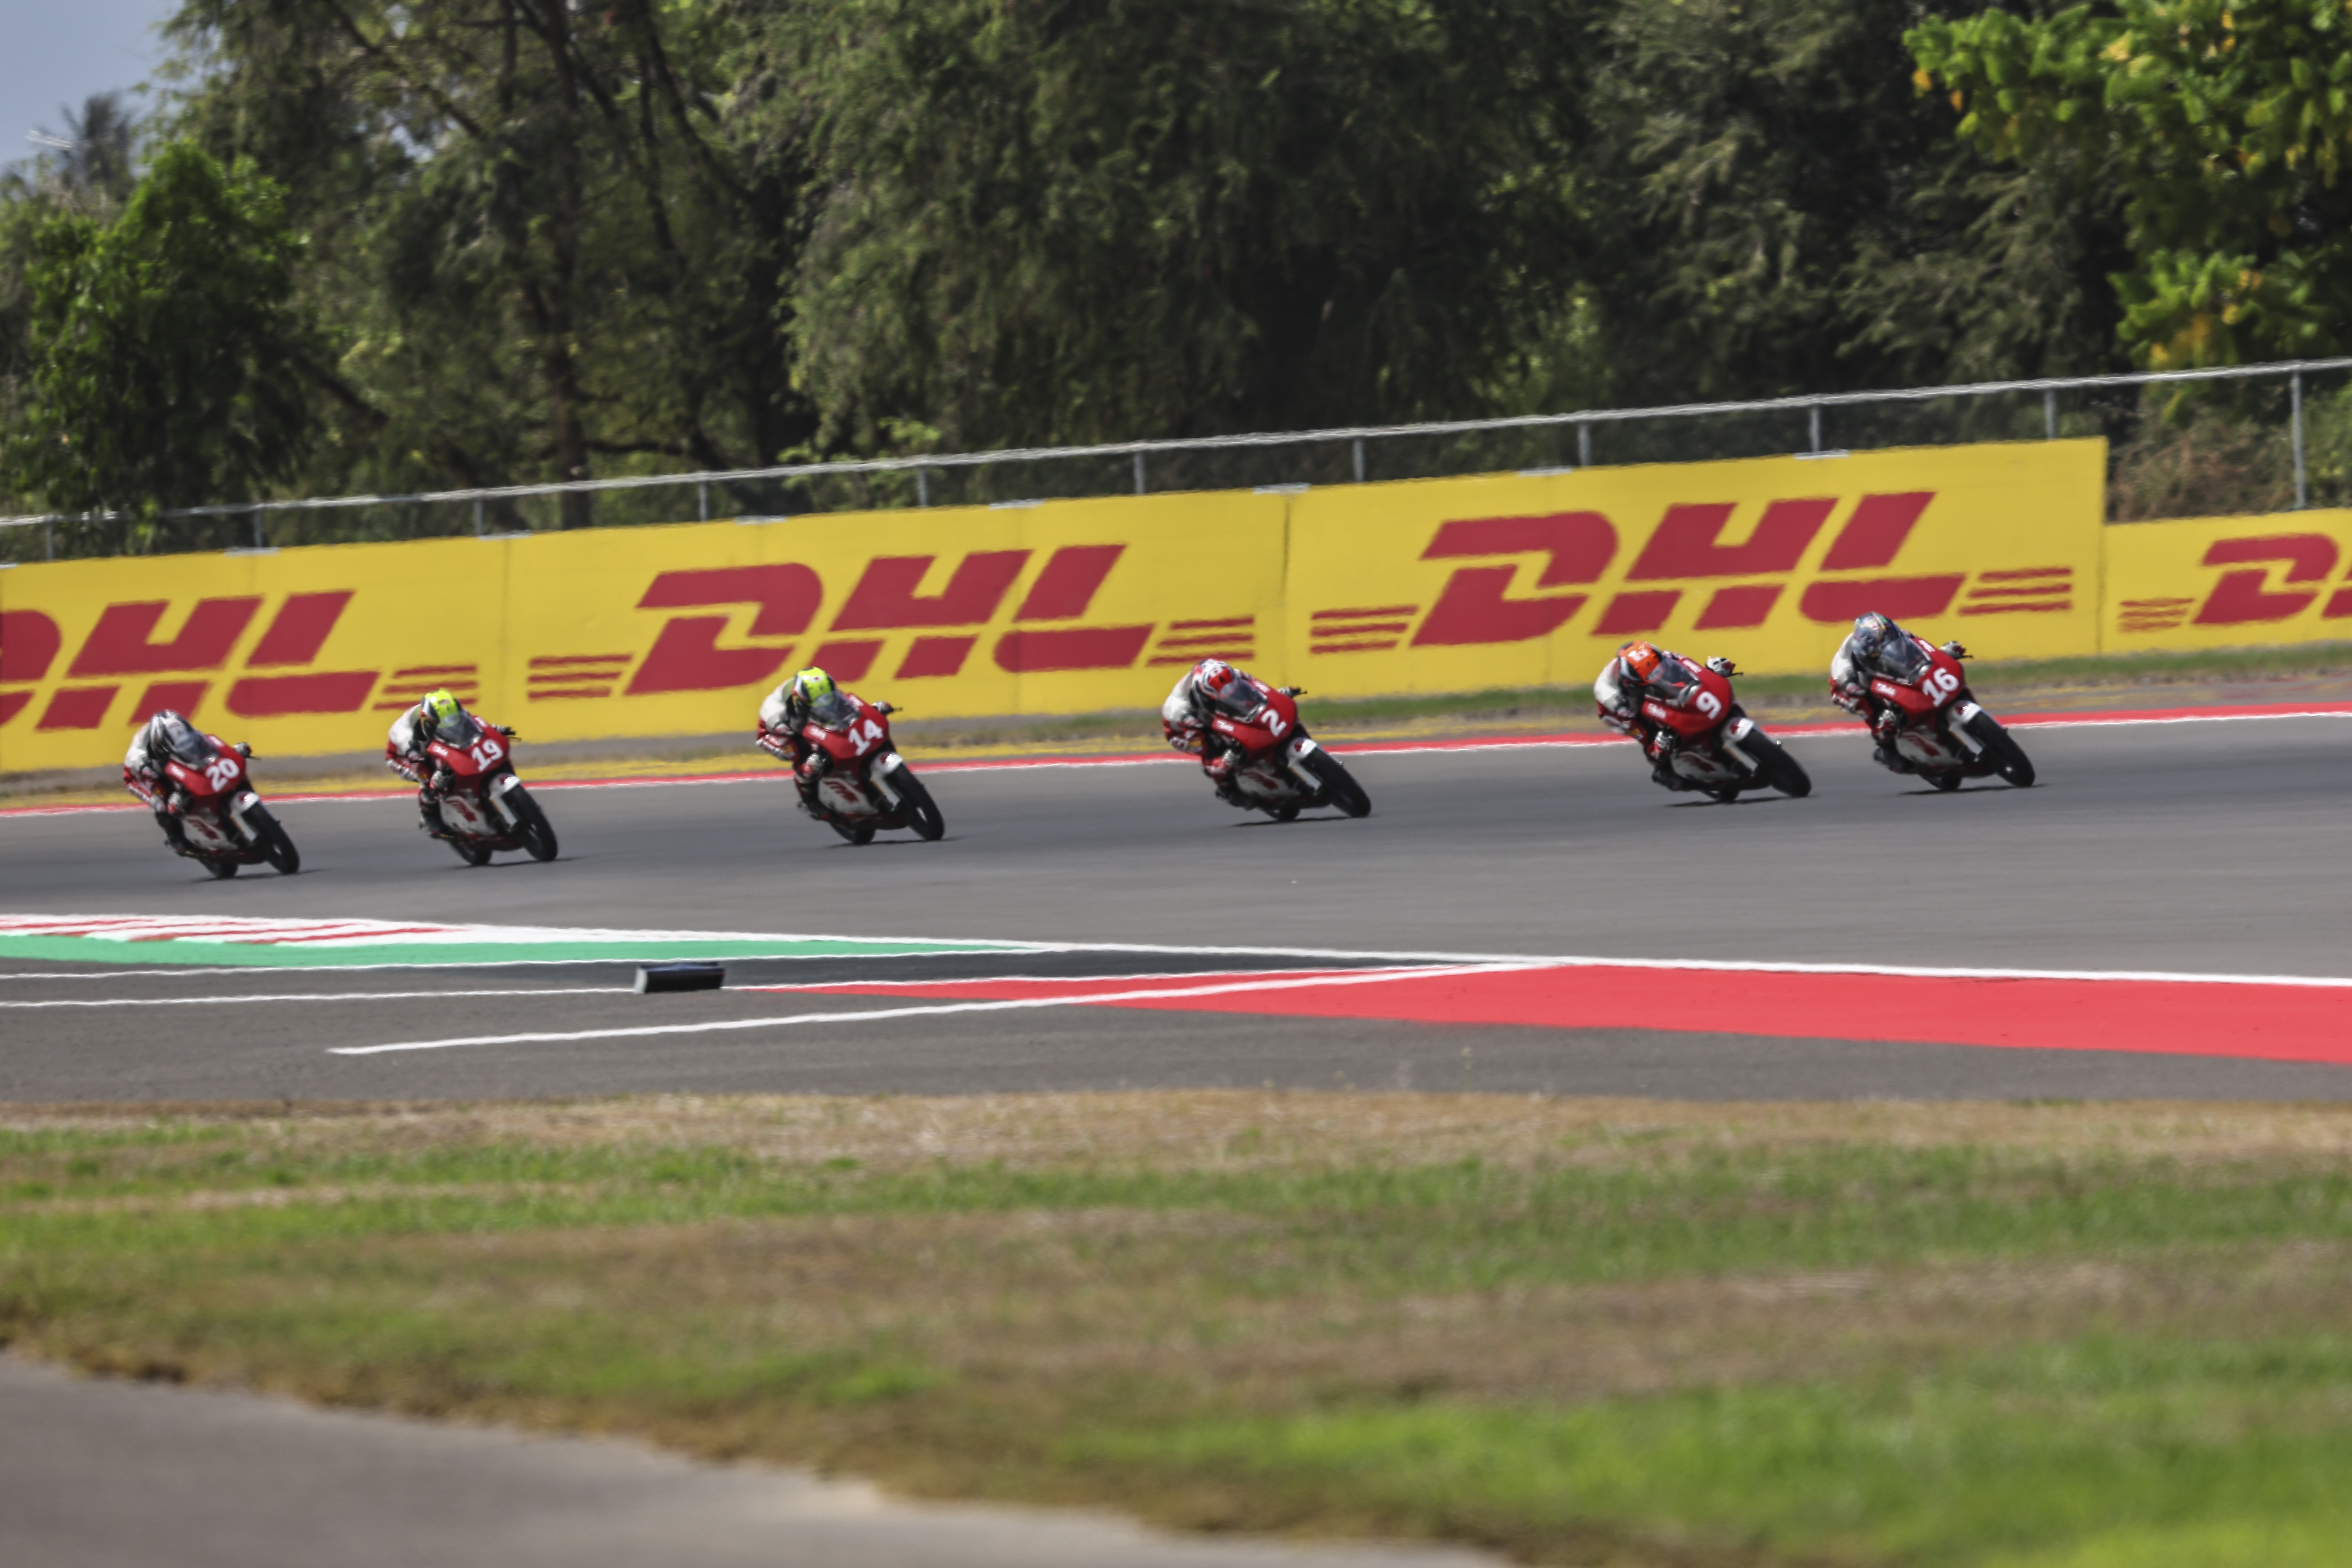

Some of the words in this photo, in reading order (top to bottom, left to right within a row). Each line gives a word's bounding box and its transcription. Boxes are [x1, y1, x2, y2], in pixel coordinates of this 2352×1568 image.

[1411, 491, 1966, 646] DHL
[625, 544, 1154, 695] DHL
[1922, 667, 1960, 707] 16
[1261, 709, 1287, 737] 2
[1696, 691, 1721, 720] 9
[472, 739, 503, 772] 19
[848, 719, 884, 756] 14
[206, 757, 240, 792] 20
